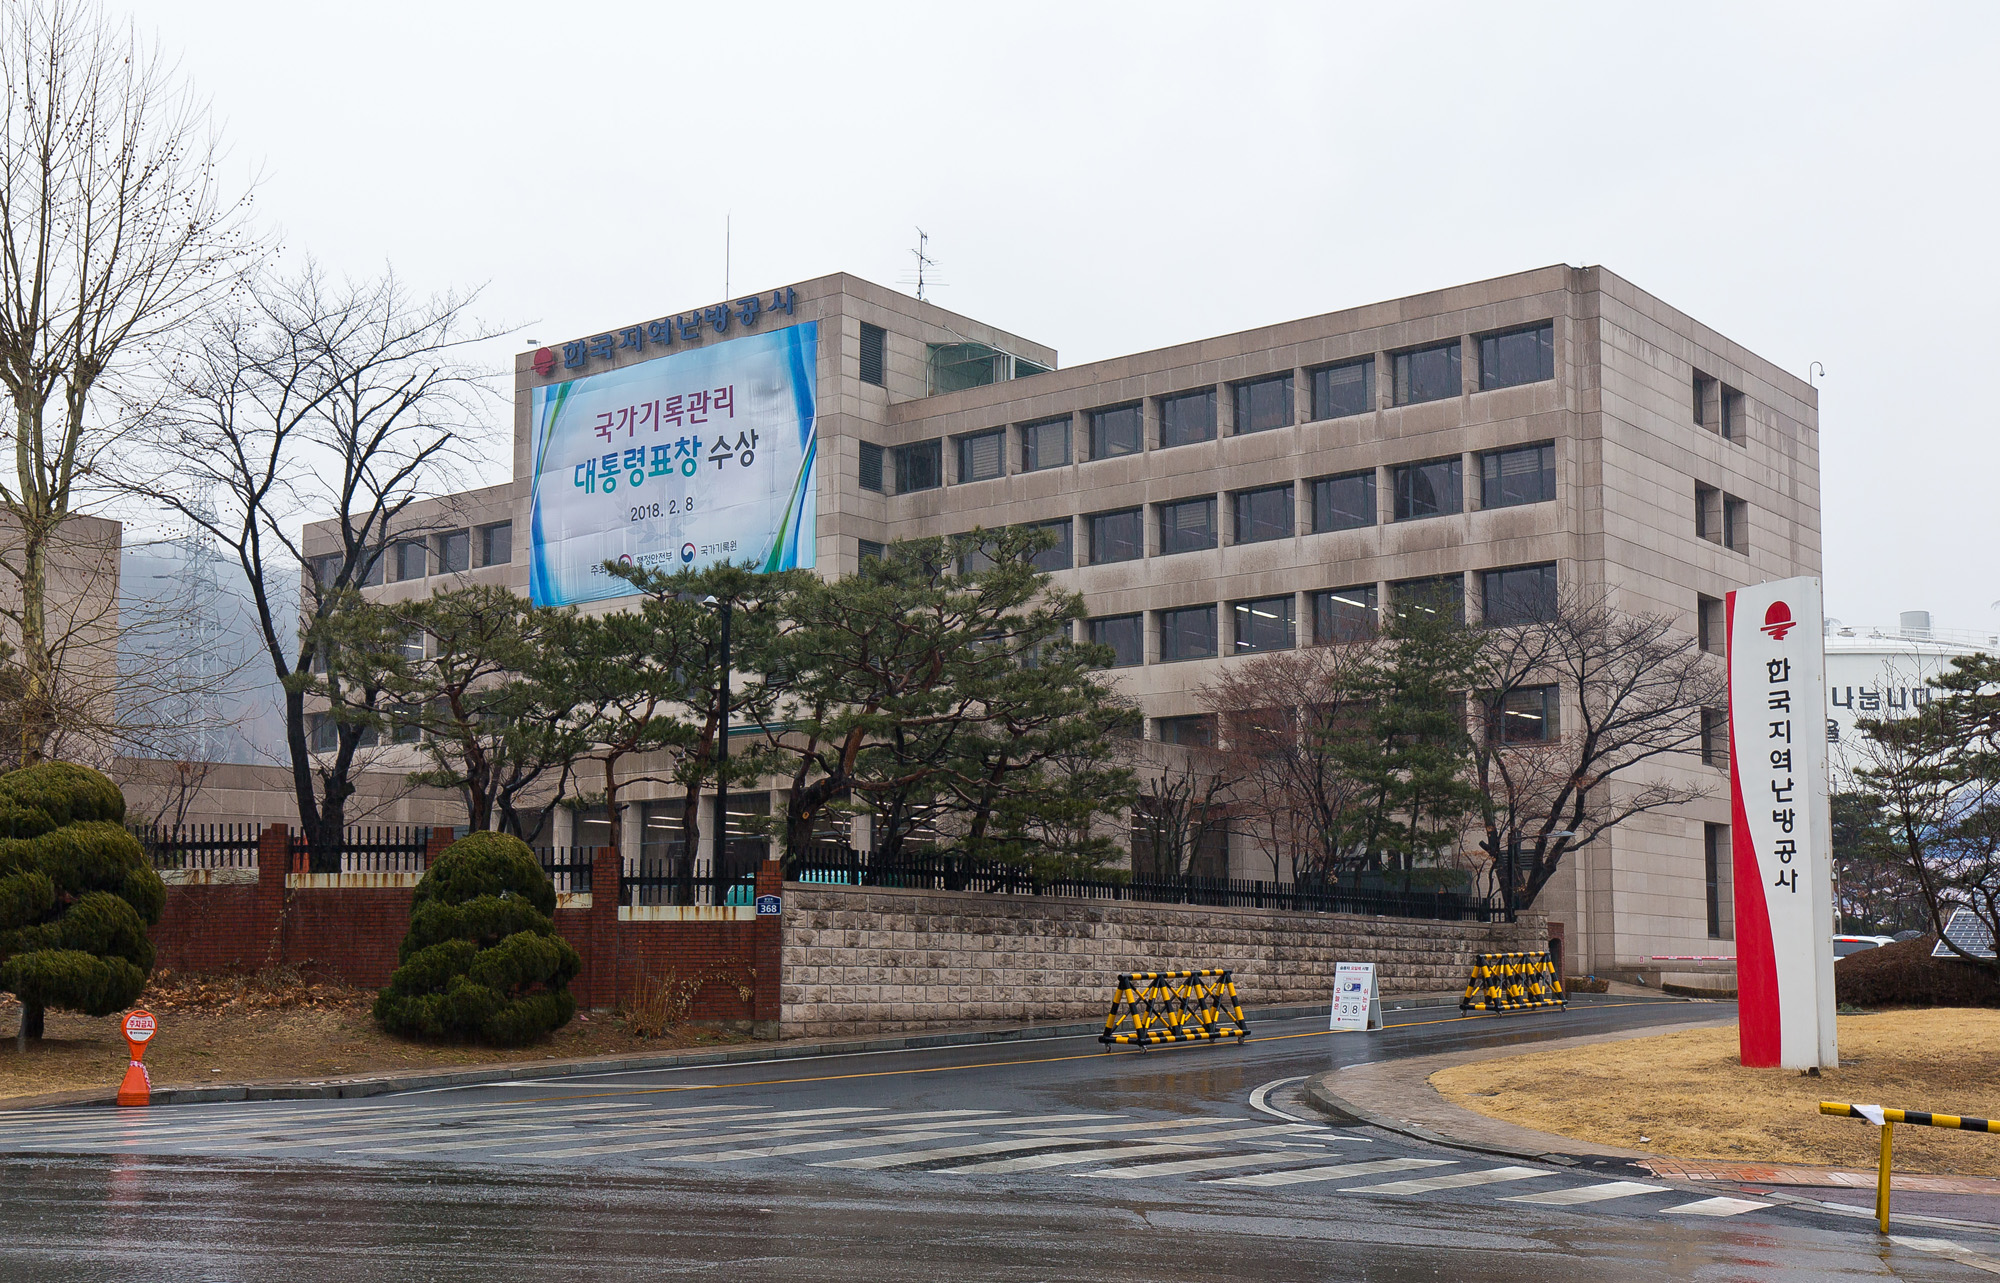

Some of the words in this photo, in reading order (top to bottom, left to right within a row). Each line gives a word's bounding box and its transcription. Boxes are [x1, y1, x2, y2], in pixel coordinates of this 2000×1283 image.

[562, 286, 797, 369] 한국지역난방공사
[594, 384, 734, 443] 국가기록관리
[574, 435, 702, 494] 대통령표창
[708, 429, 759, 470] 수상
[630, 502, 664, 522] 2018.
[669, 500, 680, 516] 2.
[685, 496, 694, 511] 8
[636, 551, 673, 566] 행정안전부
[700, 540, 737, 556] 국가기록원
[1766, 657, 1799, 894] 한국지역난방공사
[760, 904, 777, 913] 368
[1342, 1005, 1348, 1014] 3
[1352, 1005, 1358, 1014] 8
[129, 1020, 153, 1028] 주차금지
